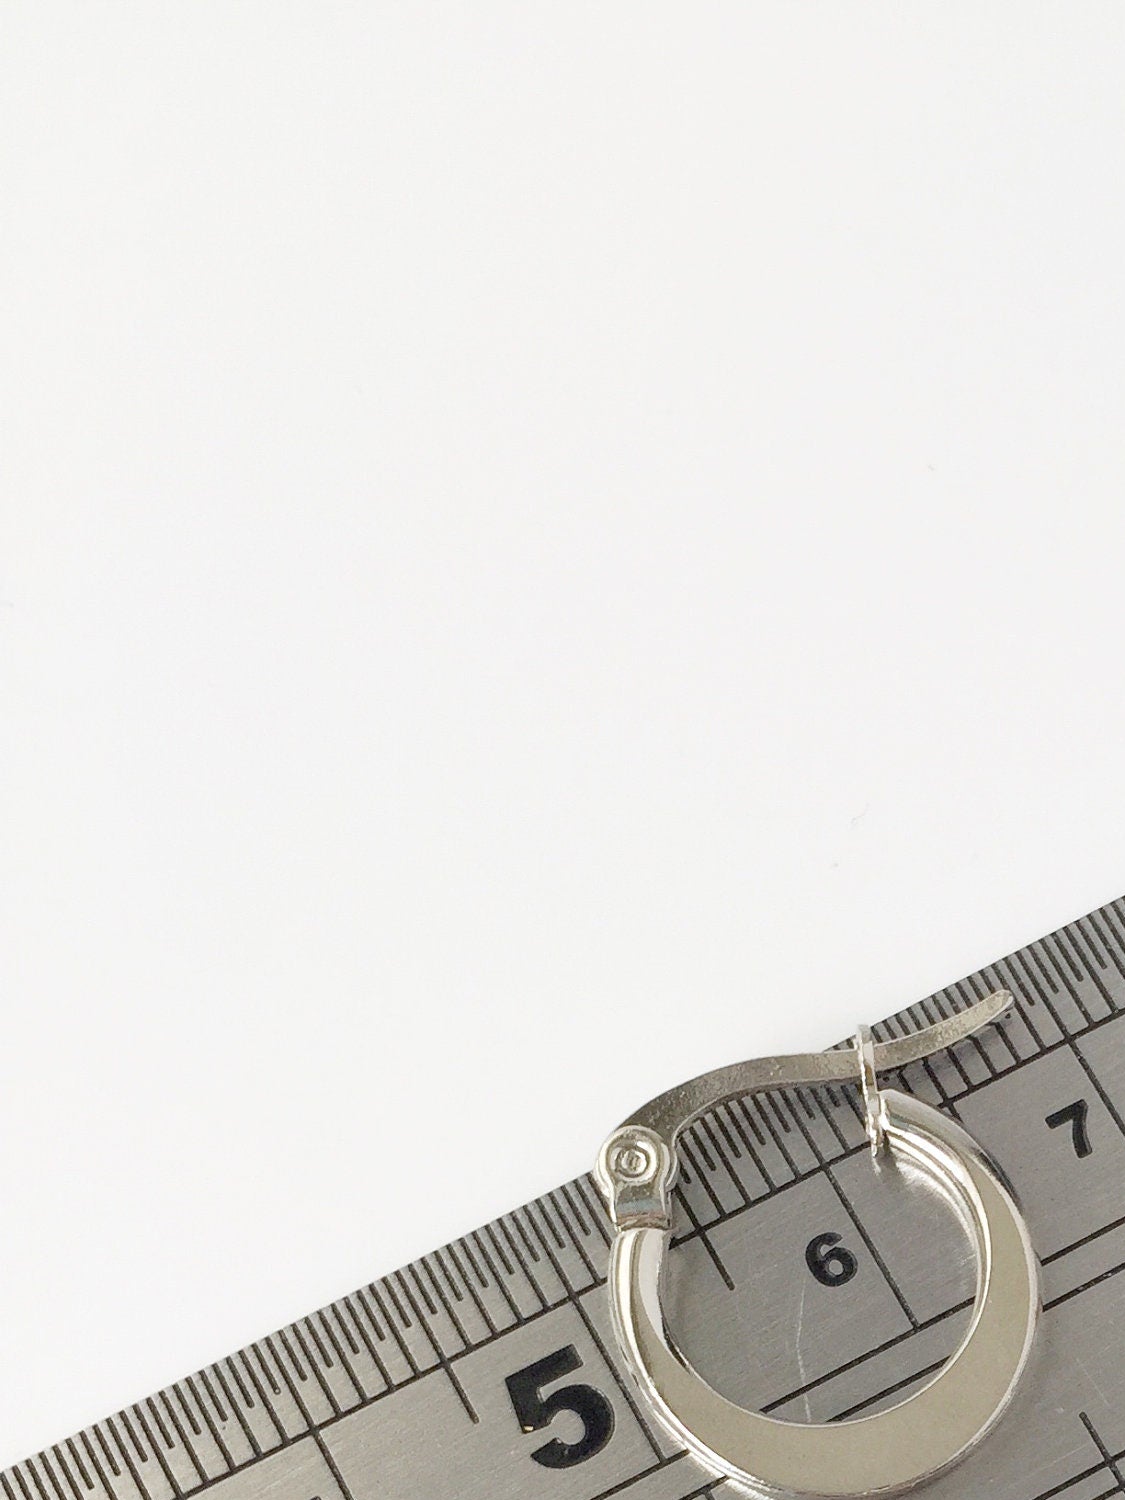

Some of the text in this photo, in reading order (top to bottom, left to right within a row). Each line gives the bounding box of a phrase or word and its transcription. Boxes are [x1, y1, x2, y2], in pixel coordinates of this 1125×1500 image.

[1045, 1099, 1093, 1158] 7
[805, 1232, 858, 1288] 6
[504, 1343, 615, 1469] 5
